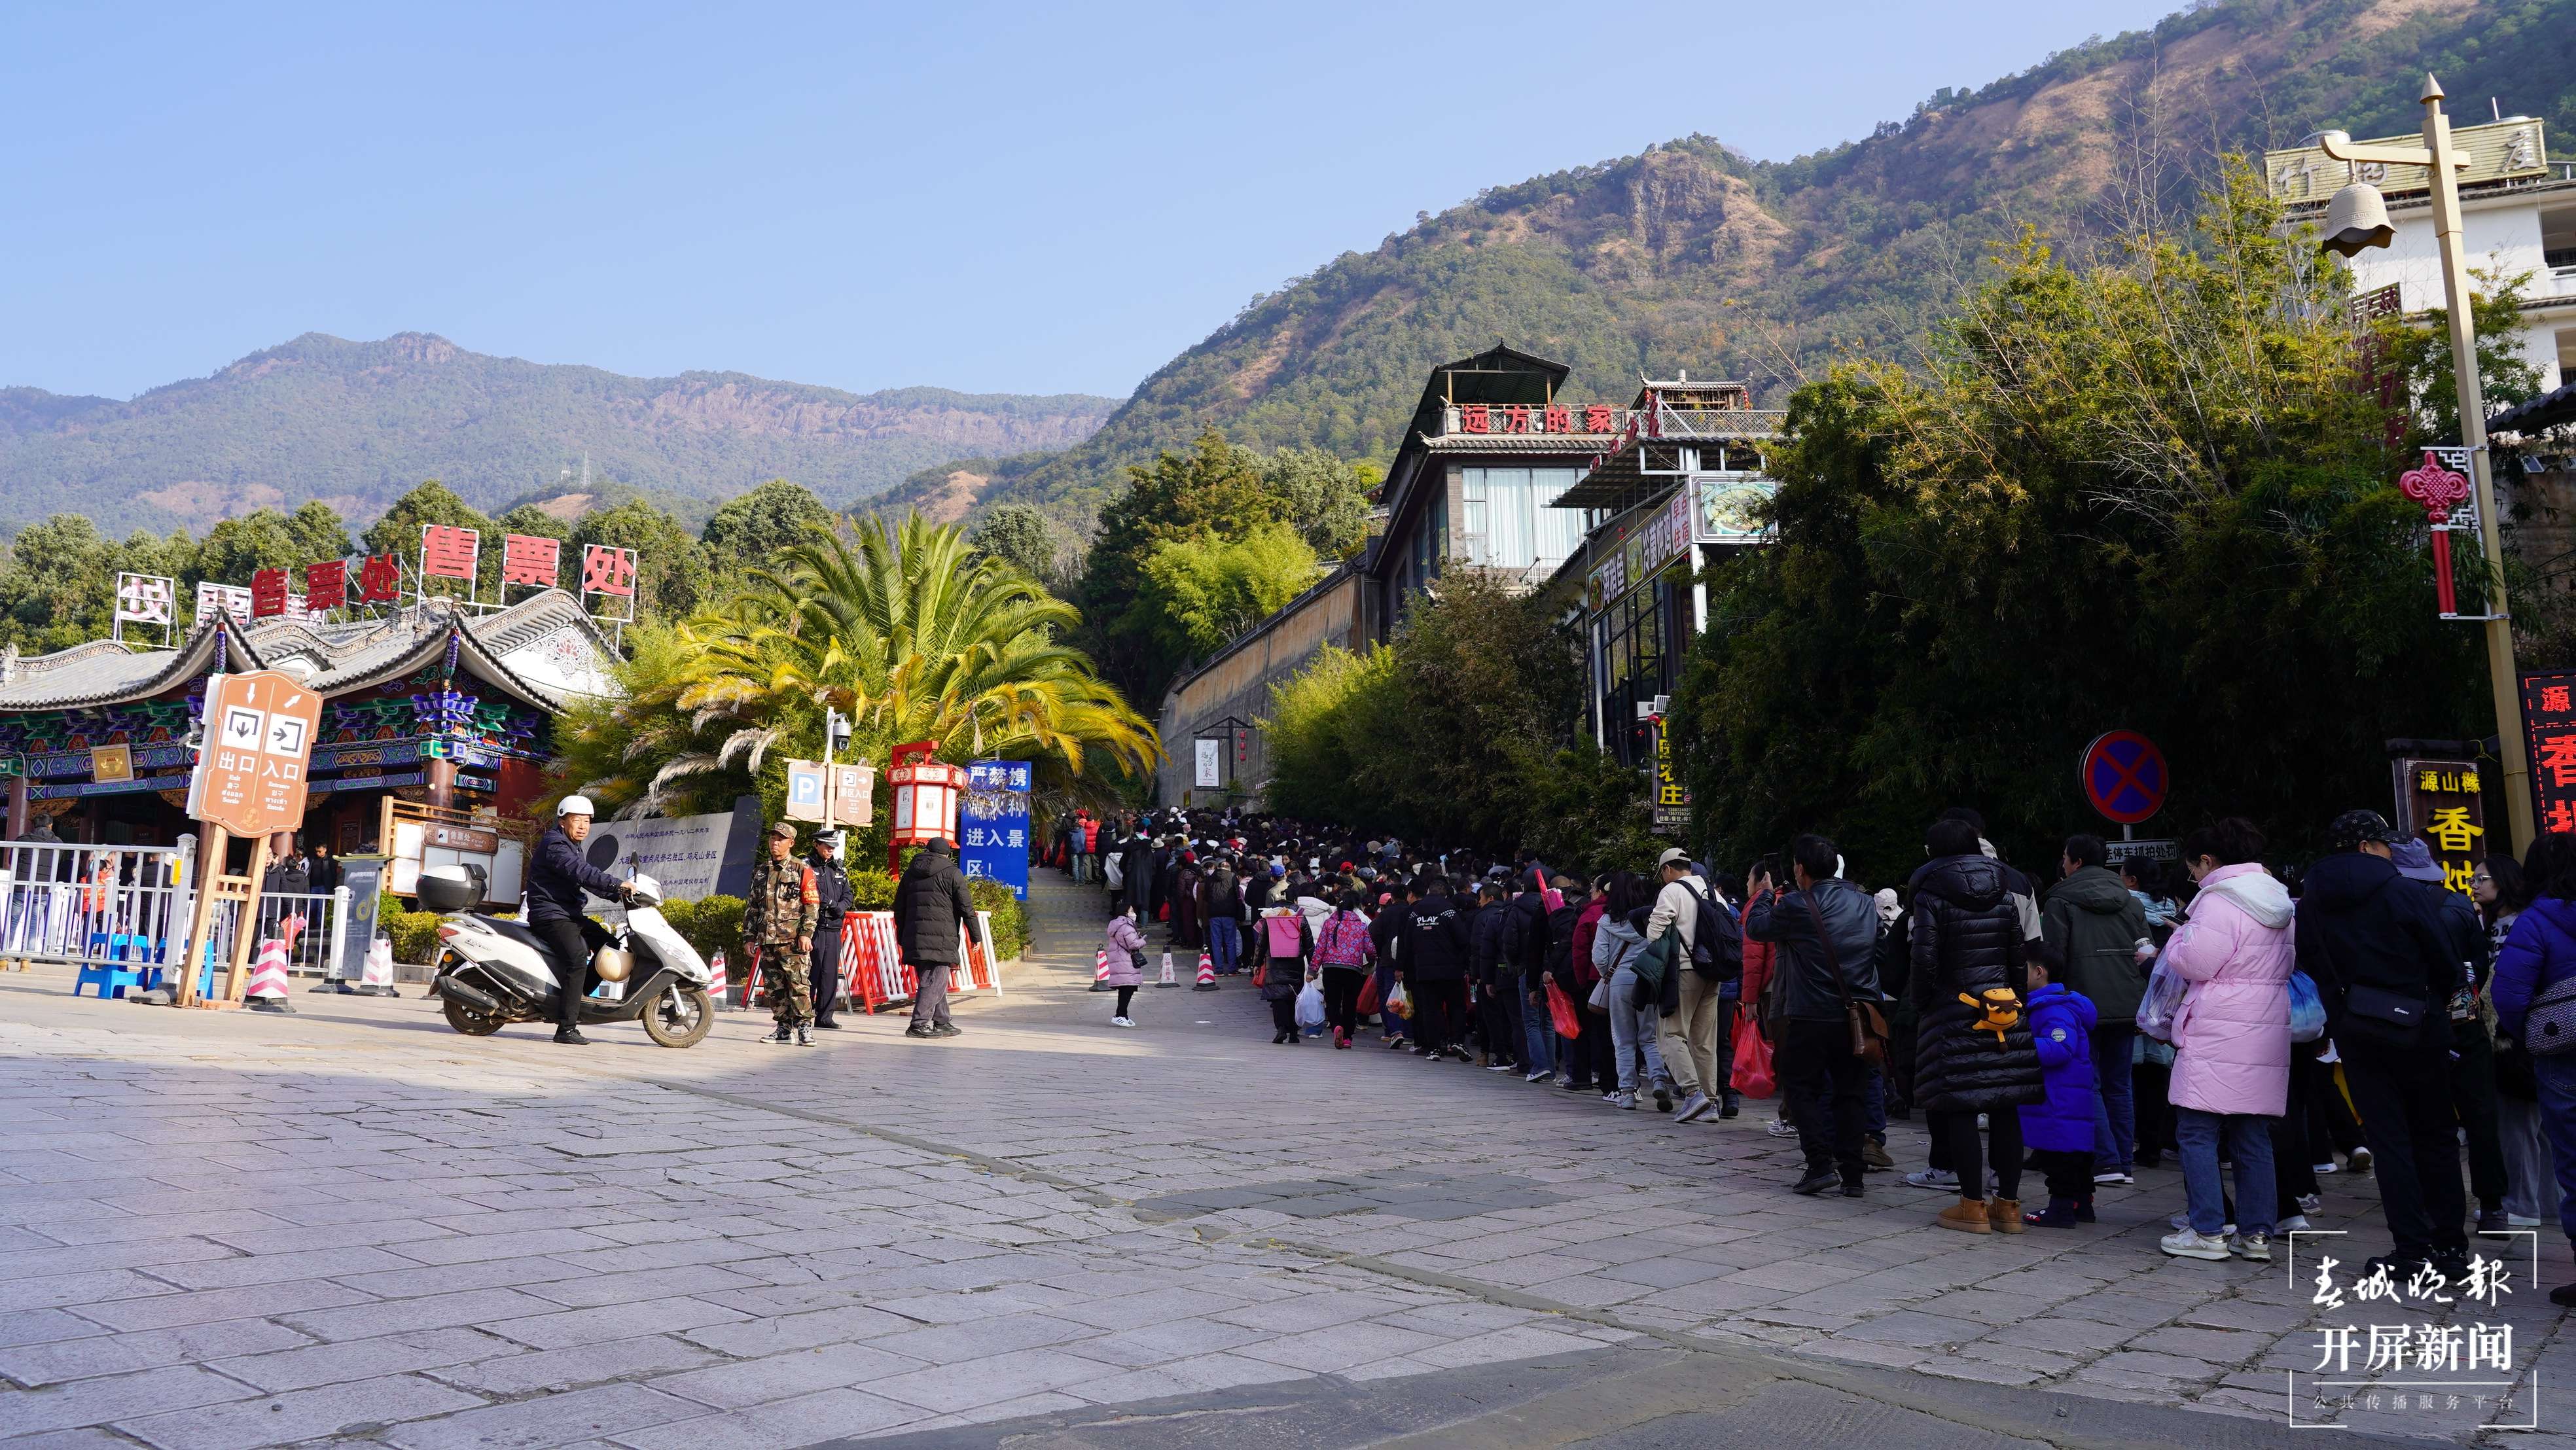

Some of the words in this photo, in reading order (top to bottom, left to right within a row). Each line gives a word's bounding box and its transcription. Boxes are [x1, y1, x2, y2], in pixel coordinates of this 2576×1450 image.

[1463, 404, 1613, 433] 远方的家
[1673, 493, 1687, 522] 早点
[1674, 521, 1689, 551] 住宿
[424, 525, 635, 596] 售票处
[251, 554, 400, 617] 售票处
[219, 752, 255, 773] 出口
[262, 760, 299, 781] 入口
[969, 766, 1027, 787] 严禁携
[798, 777, 815, 800] P
[840, 787, 870, 799] 景区入口
[450, 830, 471, 842] 售票处
[966, 828, 1025, 847] 进入景
[1417, 915, 1439, 924] PLAY
